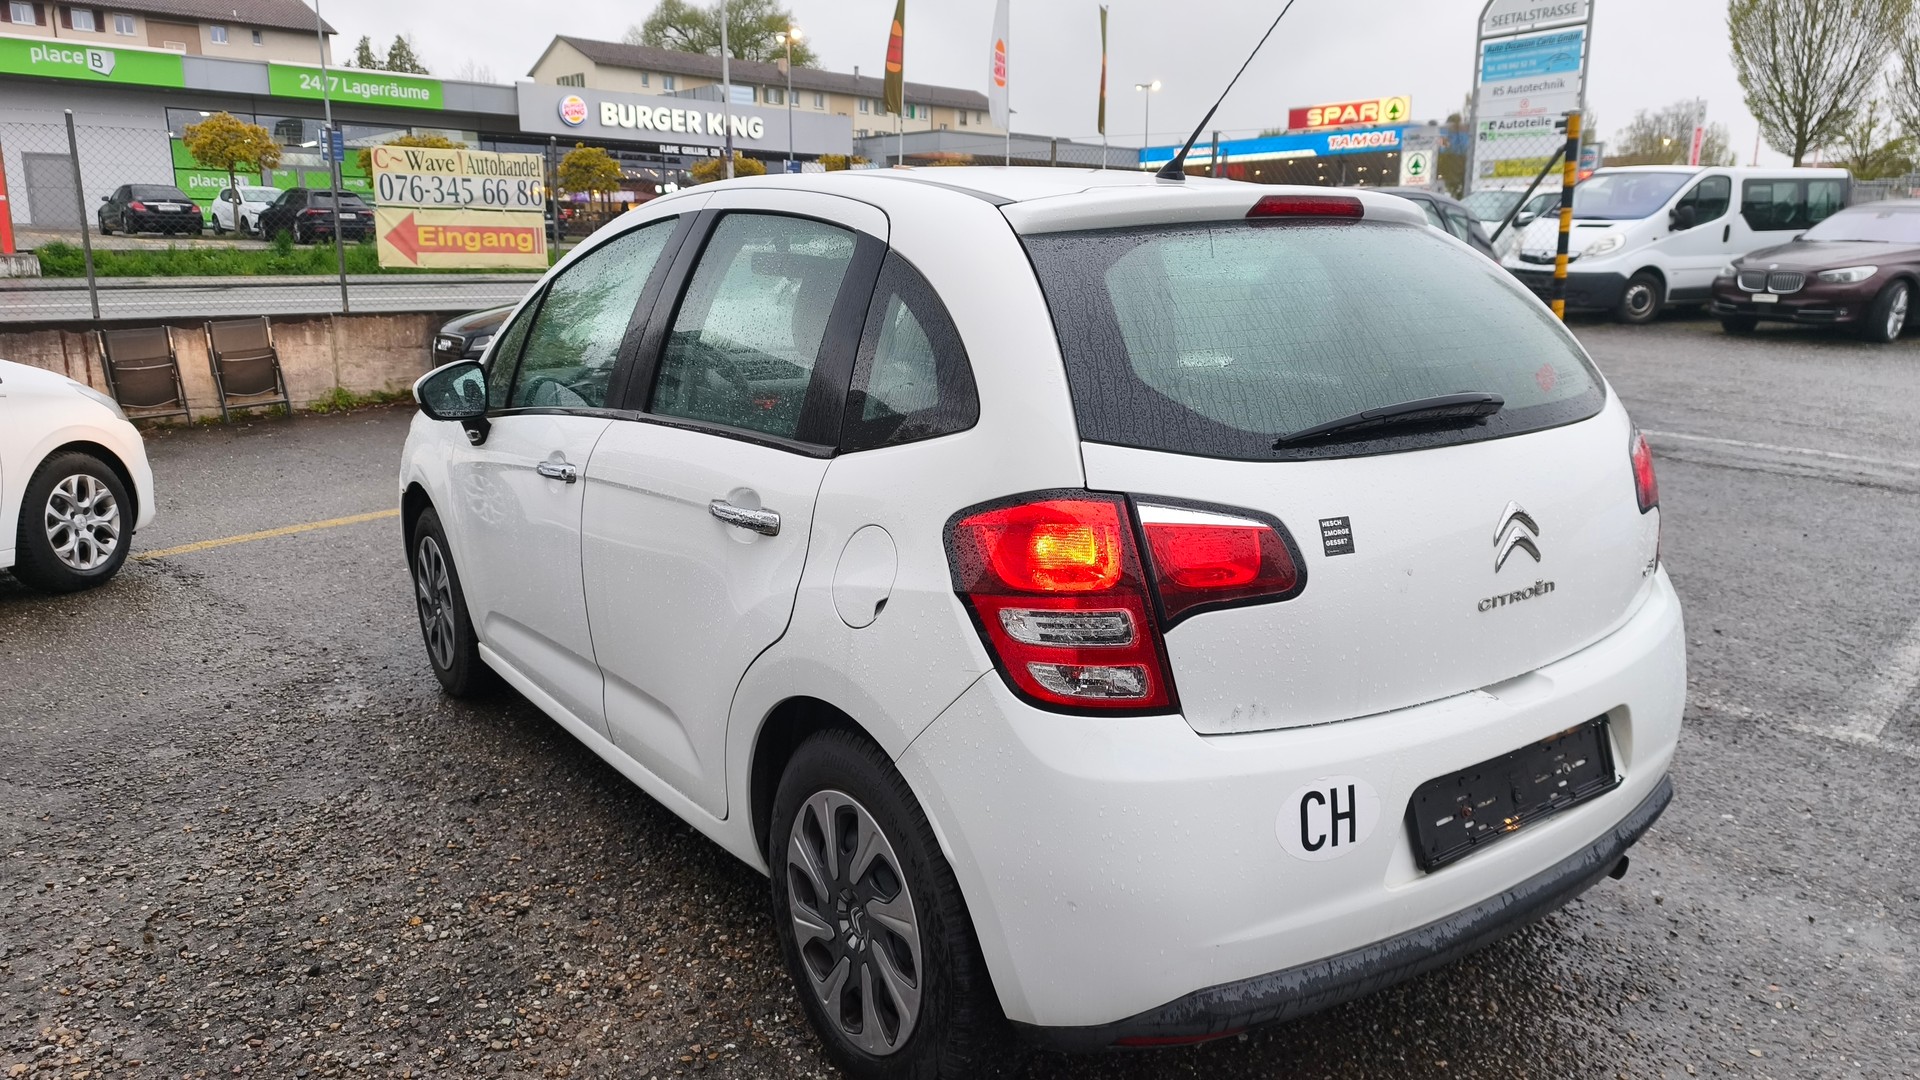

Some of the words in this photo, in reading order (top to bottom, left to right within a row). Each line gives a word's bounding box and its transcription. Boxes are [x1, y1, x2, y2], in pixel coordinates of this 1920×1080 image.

[1492, 2, 1577, 27] SEETALSTRASSE
[30, 45, 84, 63] place
[342, 78, 430, 101] Lagerräume
[1507, 80, 1565, 95] Autotechnik
[564, 108, 585, 116] KING
[600, 101, 702, 134] BURGER
[1307, 102, 1378, 126] SPAR
[1498, 117, 1551, 129] Autoteile
[660, 144, 679, 154] FLAME
[1328, 131, 1399, 150] TAMOIL
[405, 150, 455, 173] Wave
[466, 154, 541, 178] Autohandel
[189, 174, 227, 188] place
[379, 173, 474, 205] 076-345
[482, 178, 509, 205] 66
[517, 179, 542, 206] 86
[417, 226, 533, 252] Eingang
[1322, 519, 1342, 527] HESCH
[1324, 528, 1350, 537] ZMORGE
[1325, 538, 1348, 546] GESSE?
[1300, 784, 1356, 852] CH
